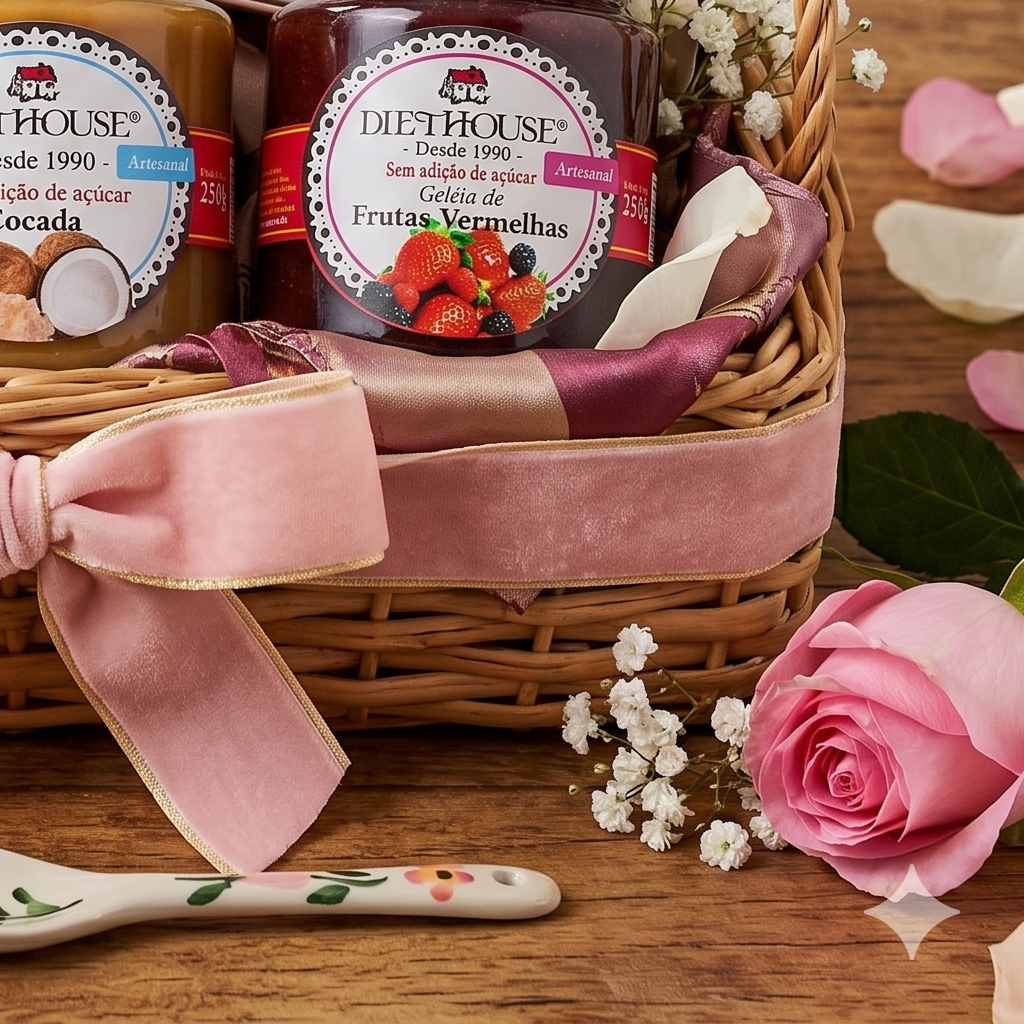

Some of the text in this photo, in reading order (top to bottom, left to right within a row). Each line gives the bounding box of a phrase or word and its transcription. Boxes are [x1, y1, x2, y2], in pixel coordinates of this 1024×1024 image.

[47, 152, 95, 170] 1990
[416, 141, 467, 157] Desde
[474, 145, 510, 161] 1990
[128, 155, 189, 173] Artesanal
[386, 161, 415, 178] Sem
[470, 164, 488, 182] de
[491, 166, 537, 187] açúcar
[554, 162, 613, 182] Artesanal
[45, 184, 66, 202] de
[73, 187, 131, 206] açúcar
[419, 185, 504, 206] Geléia de
[352, 204, 569, 239] Frutas Vermelhas
